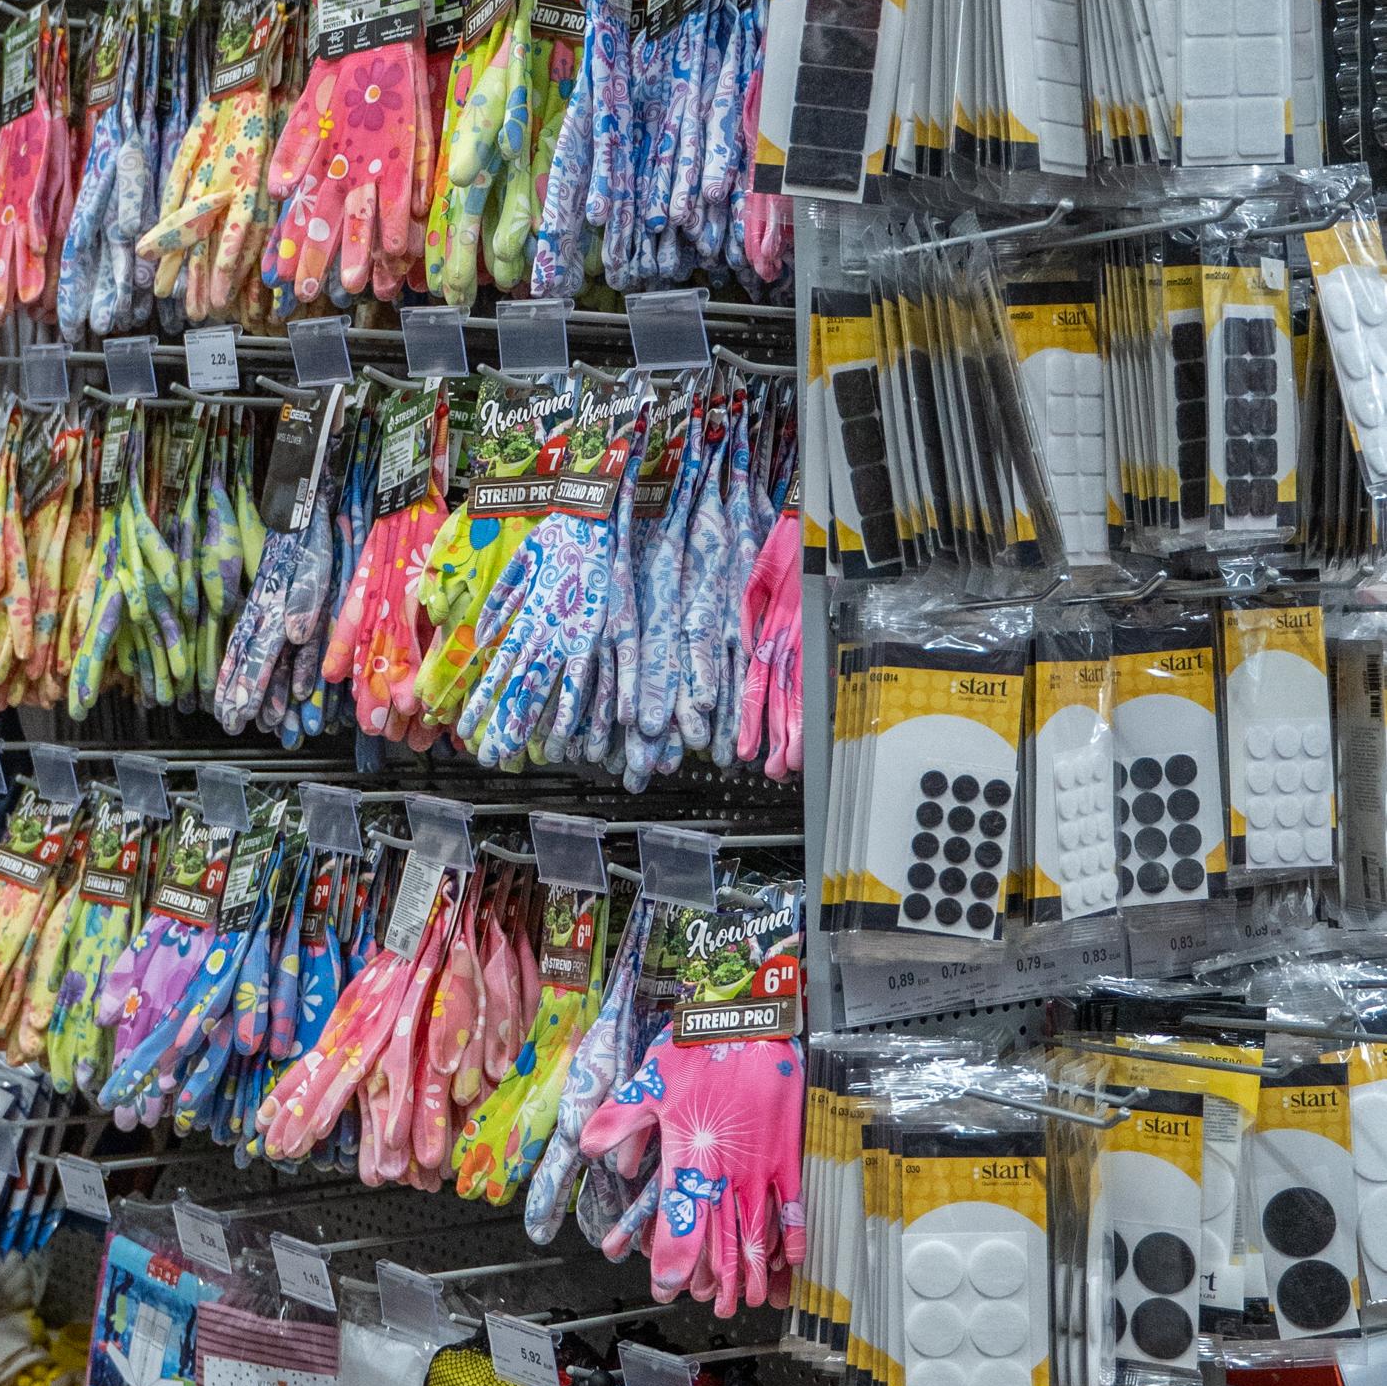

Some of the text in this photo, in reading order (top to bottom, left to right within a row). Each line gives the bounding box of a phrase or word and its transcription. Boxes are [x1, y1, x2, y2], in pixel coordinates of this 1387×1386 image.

[563, 13, 586, 32] PRO
[215, 62, 257, 89] STREND PRO
[1057, 309, 1088, 326] start
[394, 405, 418, 425] STREND
[480, 390, 576, 439] Arowana
[578, 390, 639, 429] Arowana
[608, 449, 625, 470] 7"
[478, 486, 526, 506] STREND
[557, 482, 605, 503] STREND PRO
[1276, 610, 1313, 630] start
[1160, 652, 1204, 672] start
[1079, 665, 1106, 683] start
[958, 676, 1008, 698] start
[39, 842, 60, 860] 6"
[122, 849, 137, 870] 6"
[21, 863, 40, 881] PRO
[206, 868, 224, 891] 6"
[85, 875, 125, 896] STREND PRO
[314, 884, 329, 906] 6"
[160, 888, 209, 913] STREND PRO
[576, 927, 592, 949] 6"
[685, 905, 794, 960] Arowana
[1170, 934, 1195, 953] 0,83
[548, 957, 572, 972] STREND
[1016, 954, 1042, 975] 0,79
[1082, 947, 1108, 966] 0,83
[763, 965, 794, 994] 6"
[888, 971, 915, 992] 0,89
[685, 1007, 775, 1032] STREND PRO
[1290, 1088, 1340, 1109] start
[1144, 1115, 1192, 1138] start
[981, 1161, 1032, 1181] start
[520, 1347, 542, 1366] 5,92
